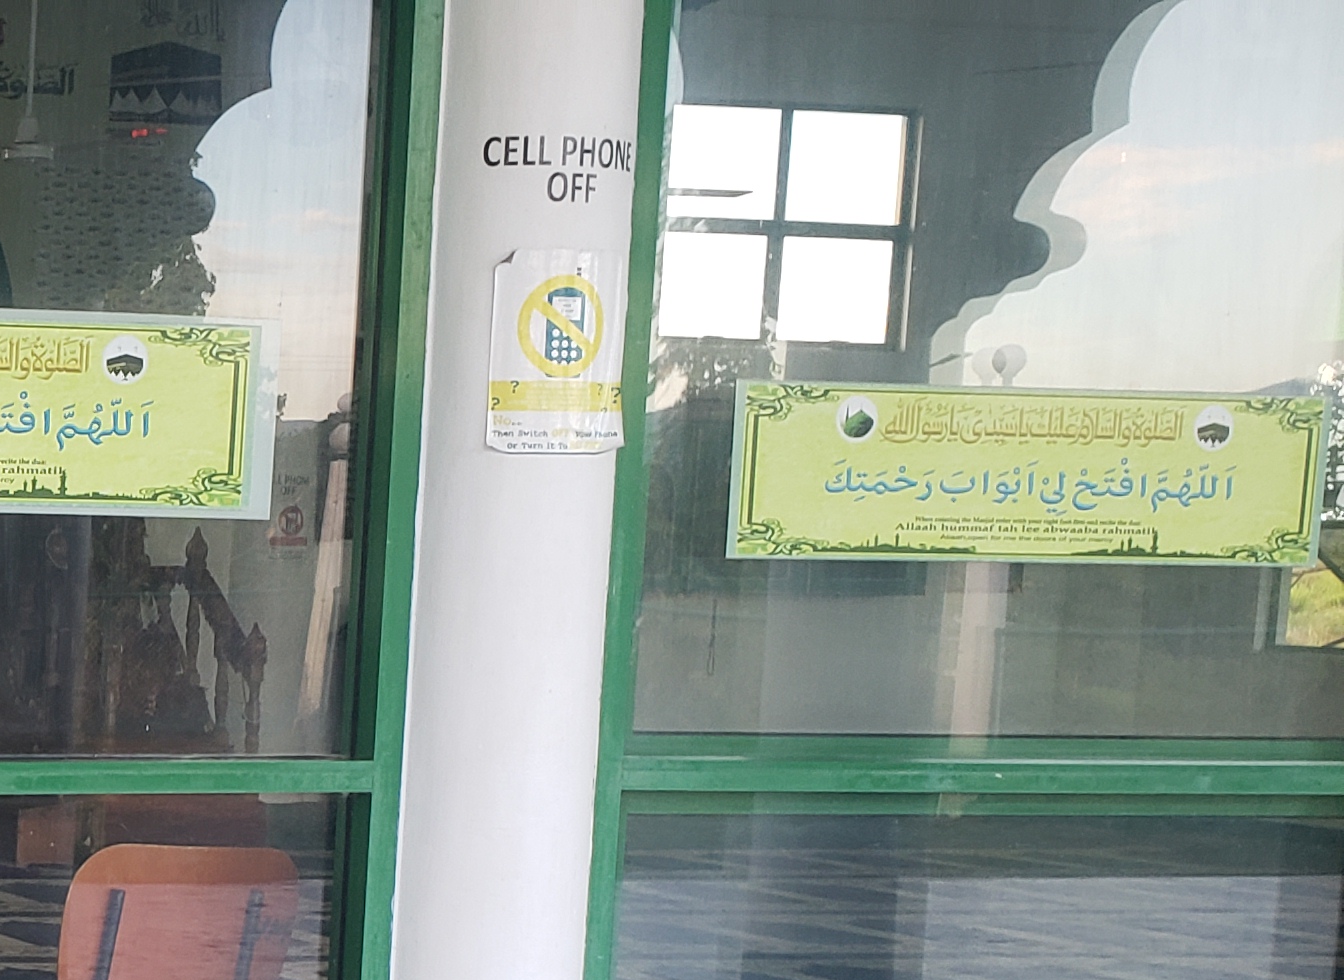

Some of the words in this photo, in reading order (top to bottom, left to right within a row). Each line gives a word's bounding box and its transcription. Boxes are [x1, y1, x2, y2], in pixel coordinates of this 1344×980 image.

[483, 135, 552, 167] CELL
[562, 136, 632, 173] PHONE
[547, 171, 598, 203] OFF
[895, 522, 937, 531] Allaah
[941, 523, 994, 532] hummaf
[998, 524, 1017, 532] tah
[1021, 525, 1040, 533] lee
[1043, 525, 1099, 534] abwaaba
